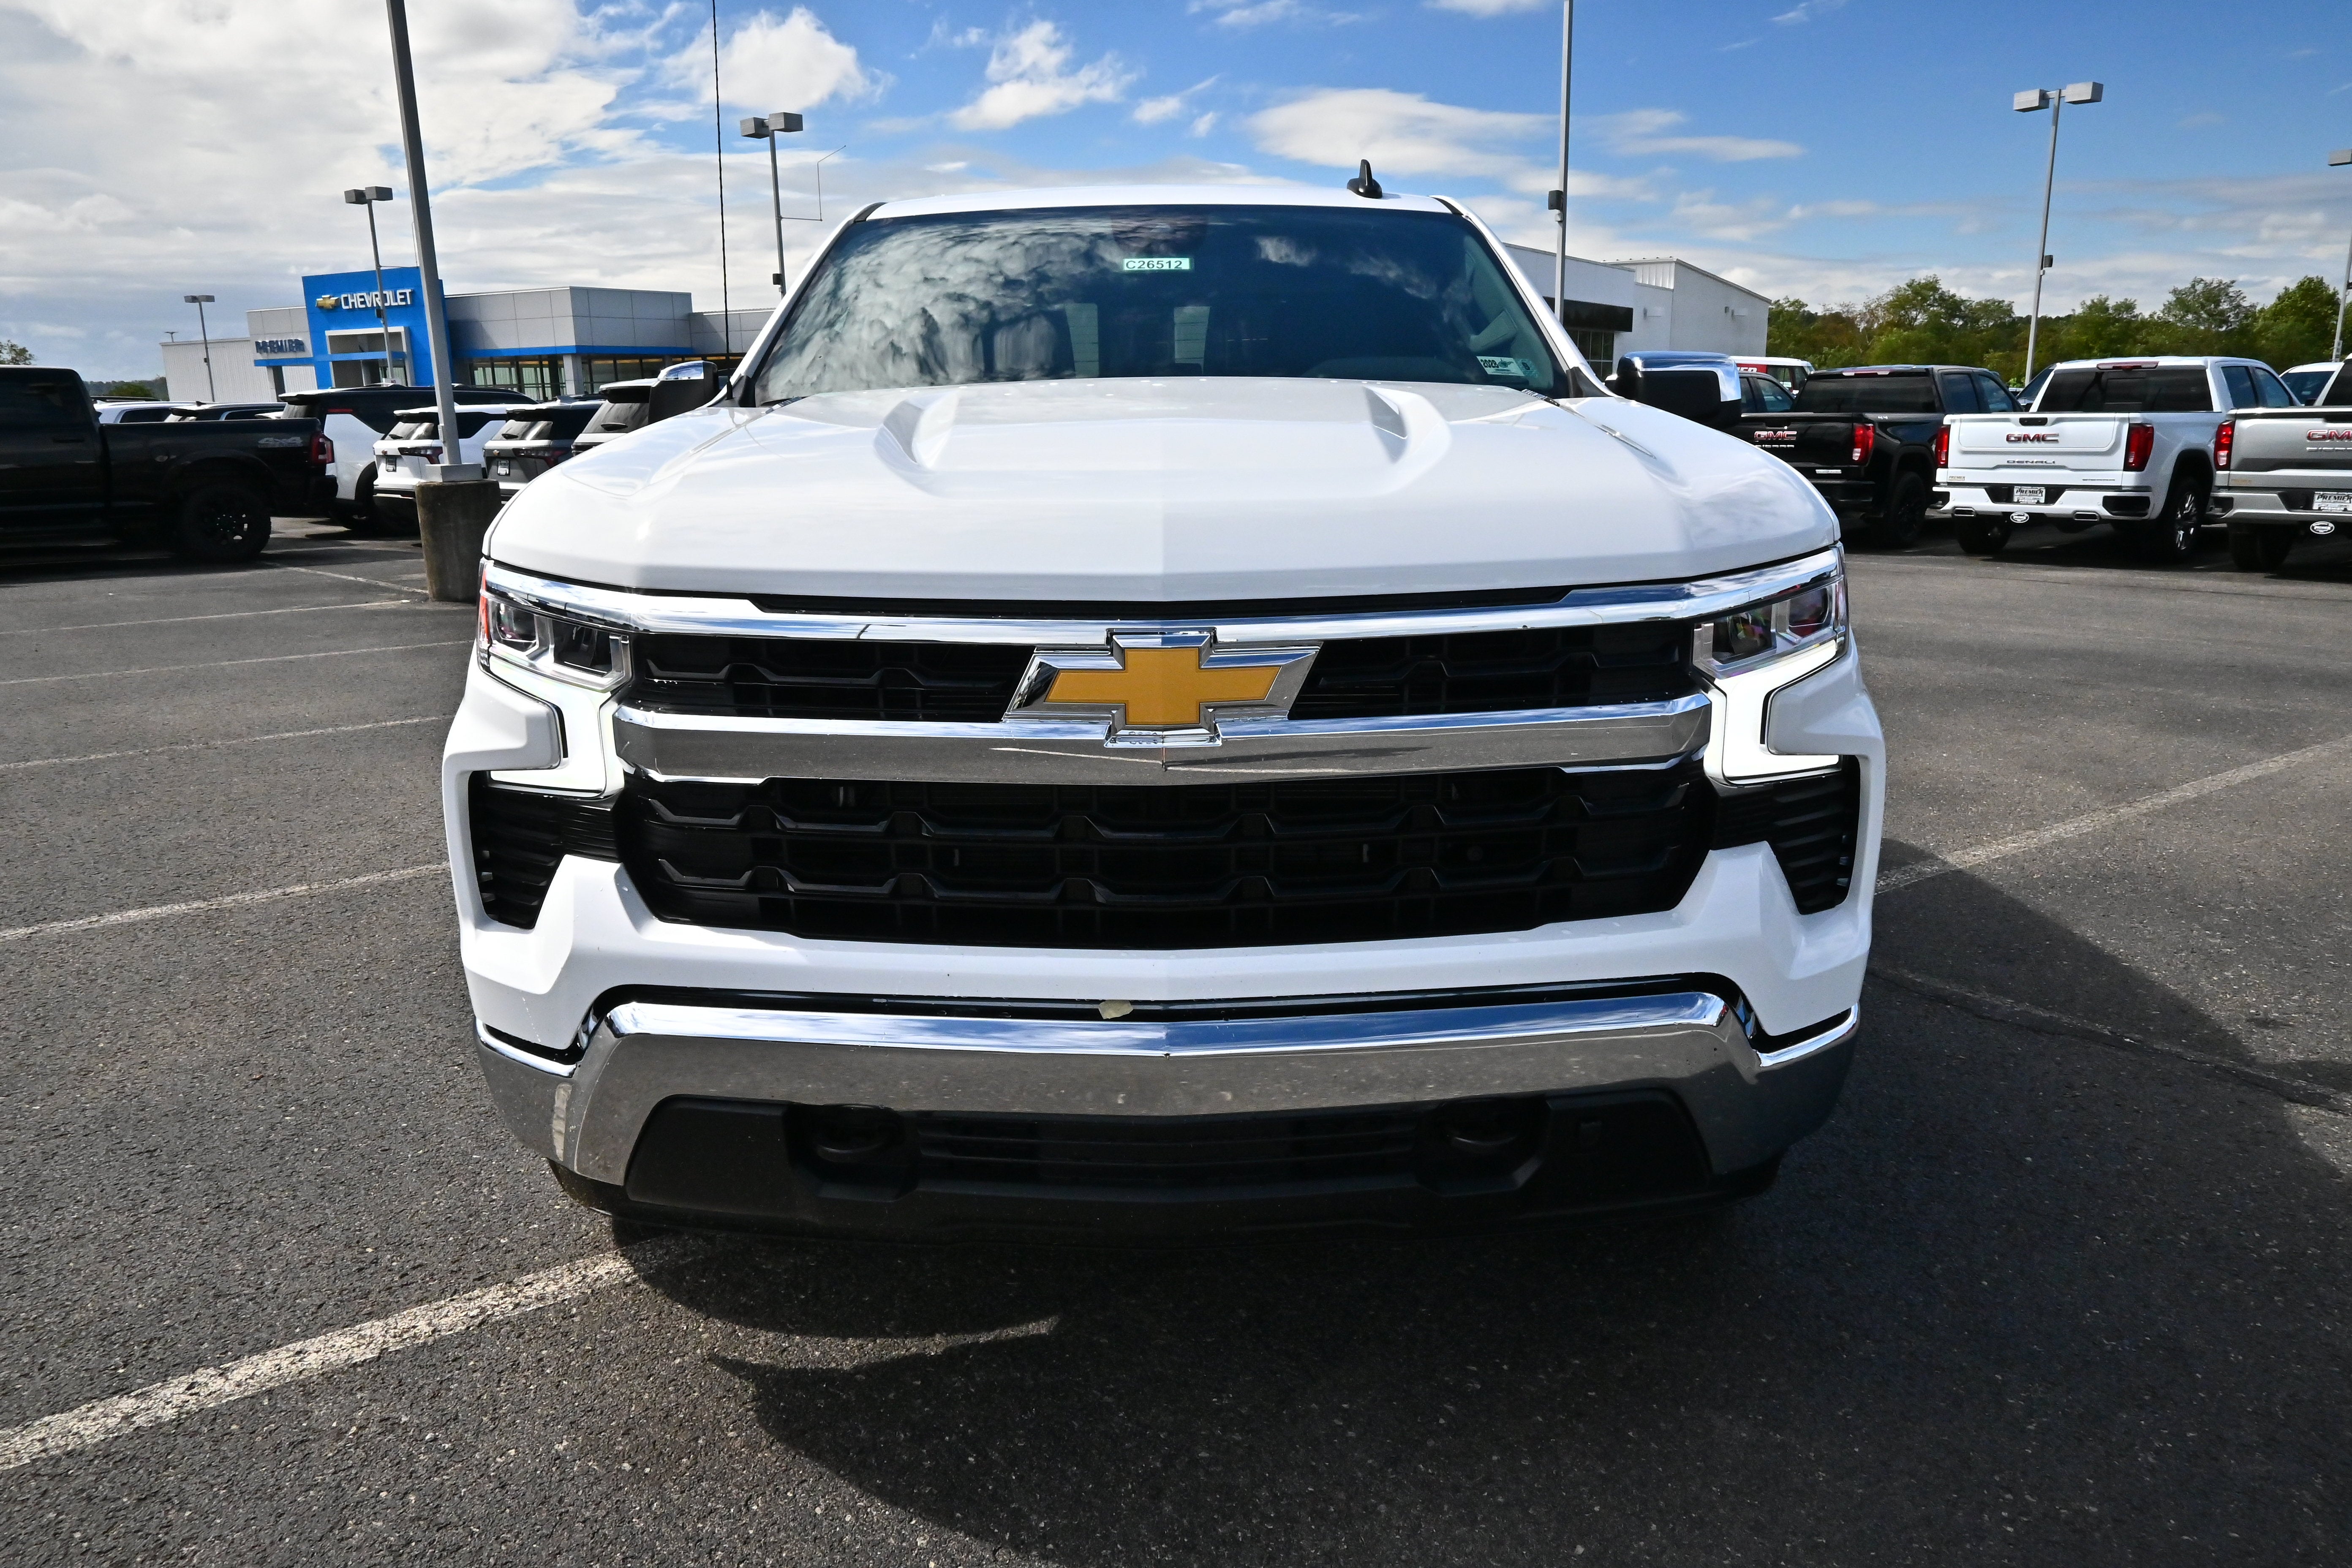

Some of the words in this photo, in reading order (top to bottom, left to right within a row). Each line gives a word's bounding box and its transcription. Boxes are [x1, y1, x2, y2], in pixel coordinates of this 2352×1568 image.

[1126, 260, 1182, 269] C26512
[340, 289, 412, 309] CHEVROLET
[1754, 431, 1797, 440] GMC
[2006, 433, 2059, 444] GMC
[2307, 429, 2352, 441] GM
[2317, 495, 2352, 504] PREMIER
